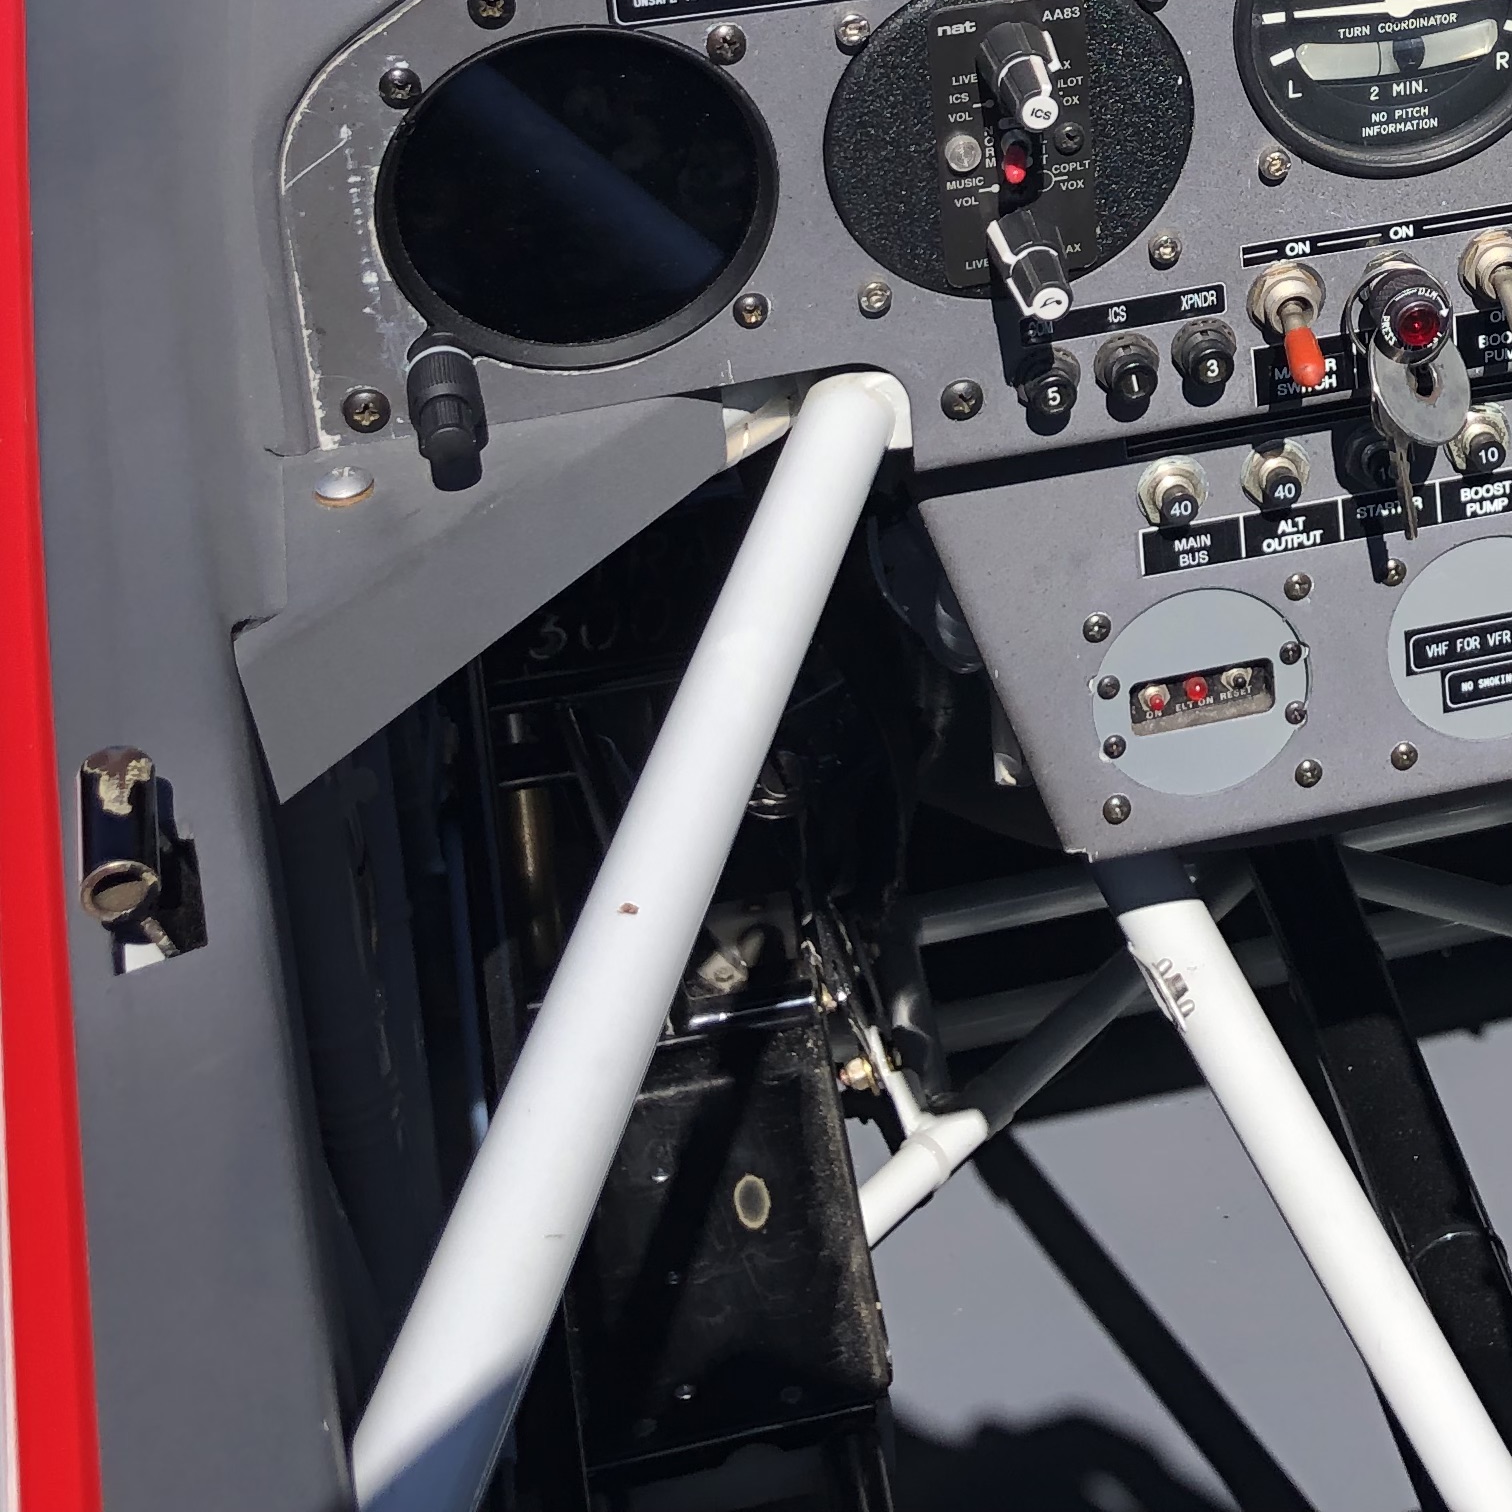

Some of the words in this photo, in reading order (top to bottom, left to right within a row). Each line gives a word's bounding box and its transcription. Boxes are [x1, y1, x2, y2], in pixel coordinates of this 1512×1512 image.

[1042, 7, 1081, 22] AA83
[1338, 25, 1370, 39] TURN
[1377, 13, 1458, 33] COORDINATOR
[1496, 51, 1509, 70] R
[952, 73, 978, 86] LIVE
[1288, 80, 1302, 99] L
[950, 93, 969, 103] ICS
[948, 112, 973, 122] VOL
[1371, 112, 1387, 123] NO
[1395, 106, 1429, 120] PITCH
[1362, 117, 1438, 137] INFORMATION
[947, 176, 984, 190] MUSIC
[1060, 179, 1085, 190] VOX
[954, 196, 979, 207] VOL
[1390, 225, 1413, 239] ON
[1285, 241, 1310, 256] ON
[1461, 480, 1512, 502] BOOST
[1466, 498, 1509, 516] PUMP
[1278, 516, 1304, 533] ALT
[1174, 534, 1211, 551] MAIN
[1262, 530, 1323, 553] OUTPUT
[1180, 550, 1208, 566] BUS
[1425, 643, 1449, 659] VHF
[1457, 635, 1481, 653] FOR
[1486, 630, 1512, 647] VFR
[1220, 685, 1252, 701] RESET
[1461, 679, 1475, 691] NO
